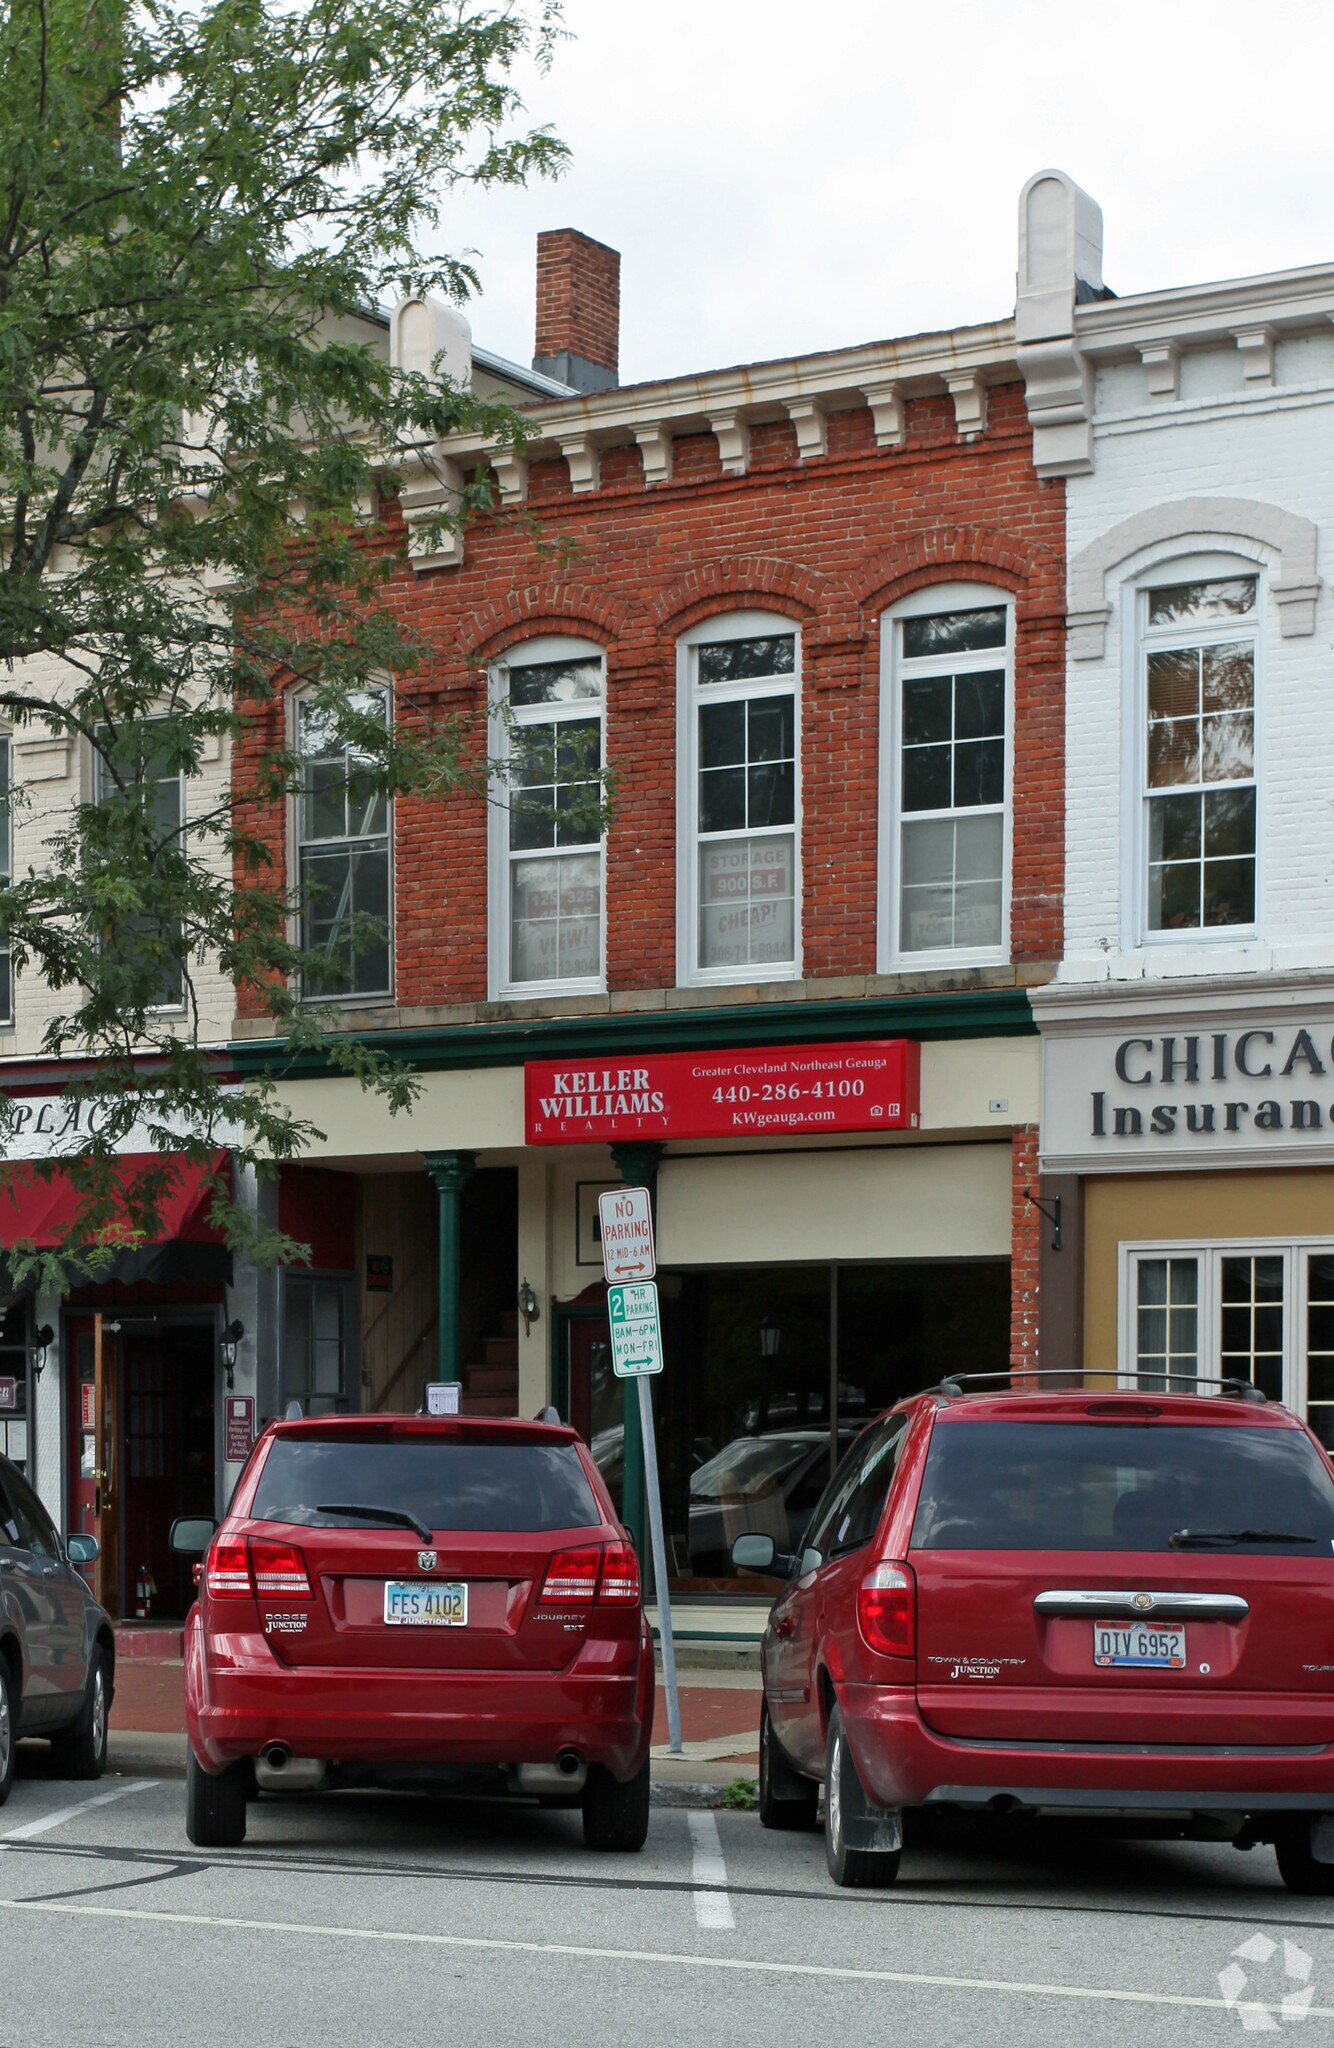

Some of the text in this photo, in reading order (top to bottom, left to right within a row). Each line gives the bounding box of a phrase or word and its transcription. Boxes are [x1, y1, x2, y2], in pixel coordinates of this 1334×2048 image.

[717, 877, 746, 893] 900
[718, 903, 777, 933] CHEAP!
[539, 926, 589, 955] VIEW!
[691, 1057, 887, 1078] Greater Cleveland Northeast Geauga
[1114, 1028, 1334, 1085] CHICA
[553, 1068, 650, 1095] KELLER
[712, 1079, 865, 1104] 440-286-4100
[539, 1091, 664, 1118] WILLIAMS
[1090, 1091, 1334, 1136] Insuran
[10, 1100, 118, 1136] PLAC
[535, 1116, 669, 1132] REALTY
[732, 1110, 836, 1127] KWgeauga.com
[615, 1200, 634, 1218] NO
[605, 1219, 648, 1241] PARKING
[607, 1248, 614, 1260] 12
[640, 1244, 650, 1256] AM
[612, 1288, 646, 1317] 2 HR
[625, 1302, 654, 1315] PARKING
[616, 1340, 658, 1355] MON-FRI
[392, 1593, 461, 1615] FES 4102
[265, 1621, 307, 1634] JUNCTION
[403, 1617, 449, 1625] JUNCTION
[1101, 1632, 1179, 1657] DIV 6952
[951, 1665, 1000, 1678] JUNCTION
